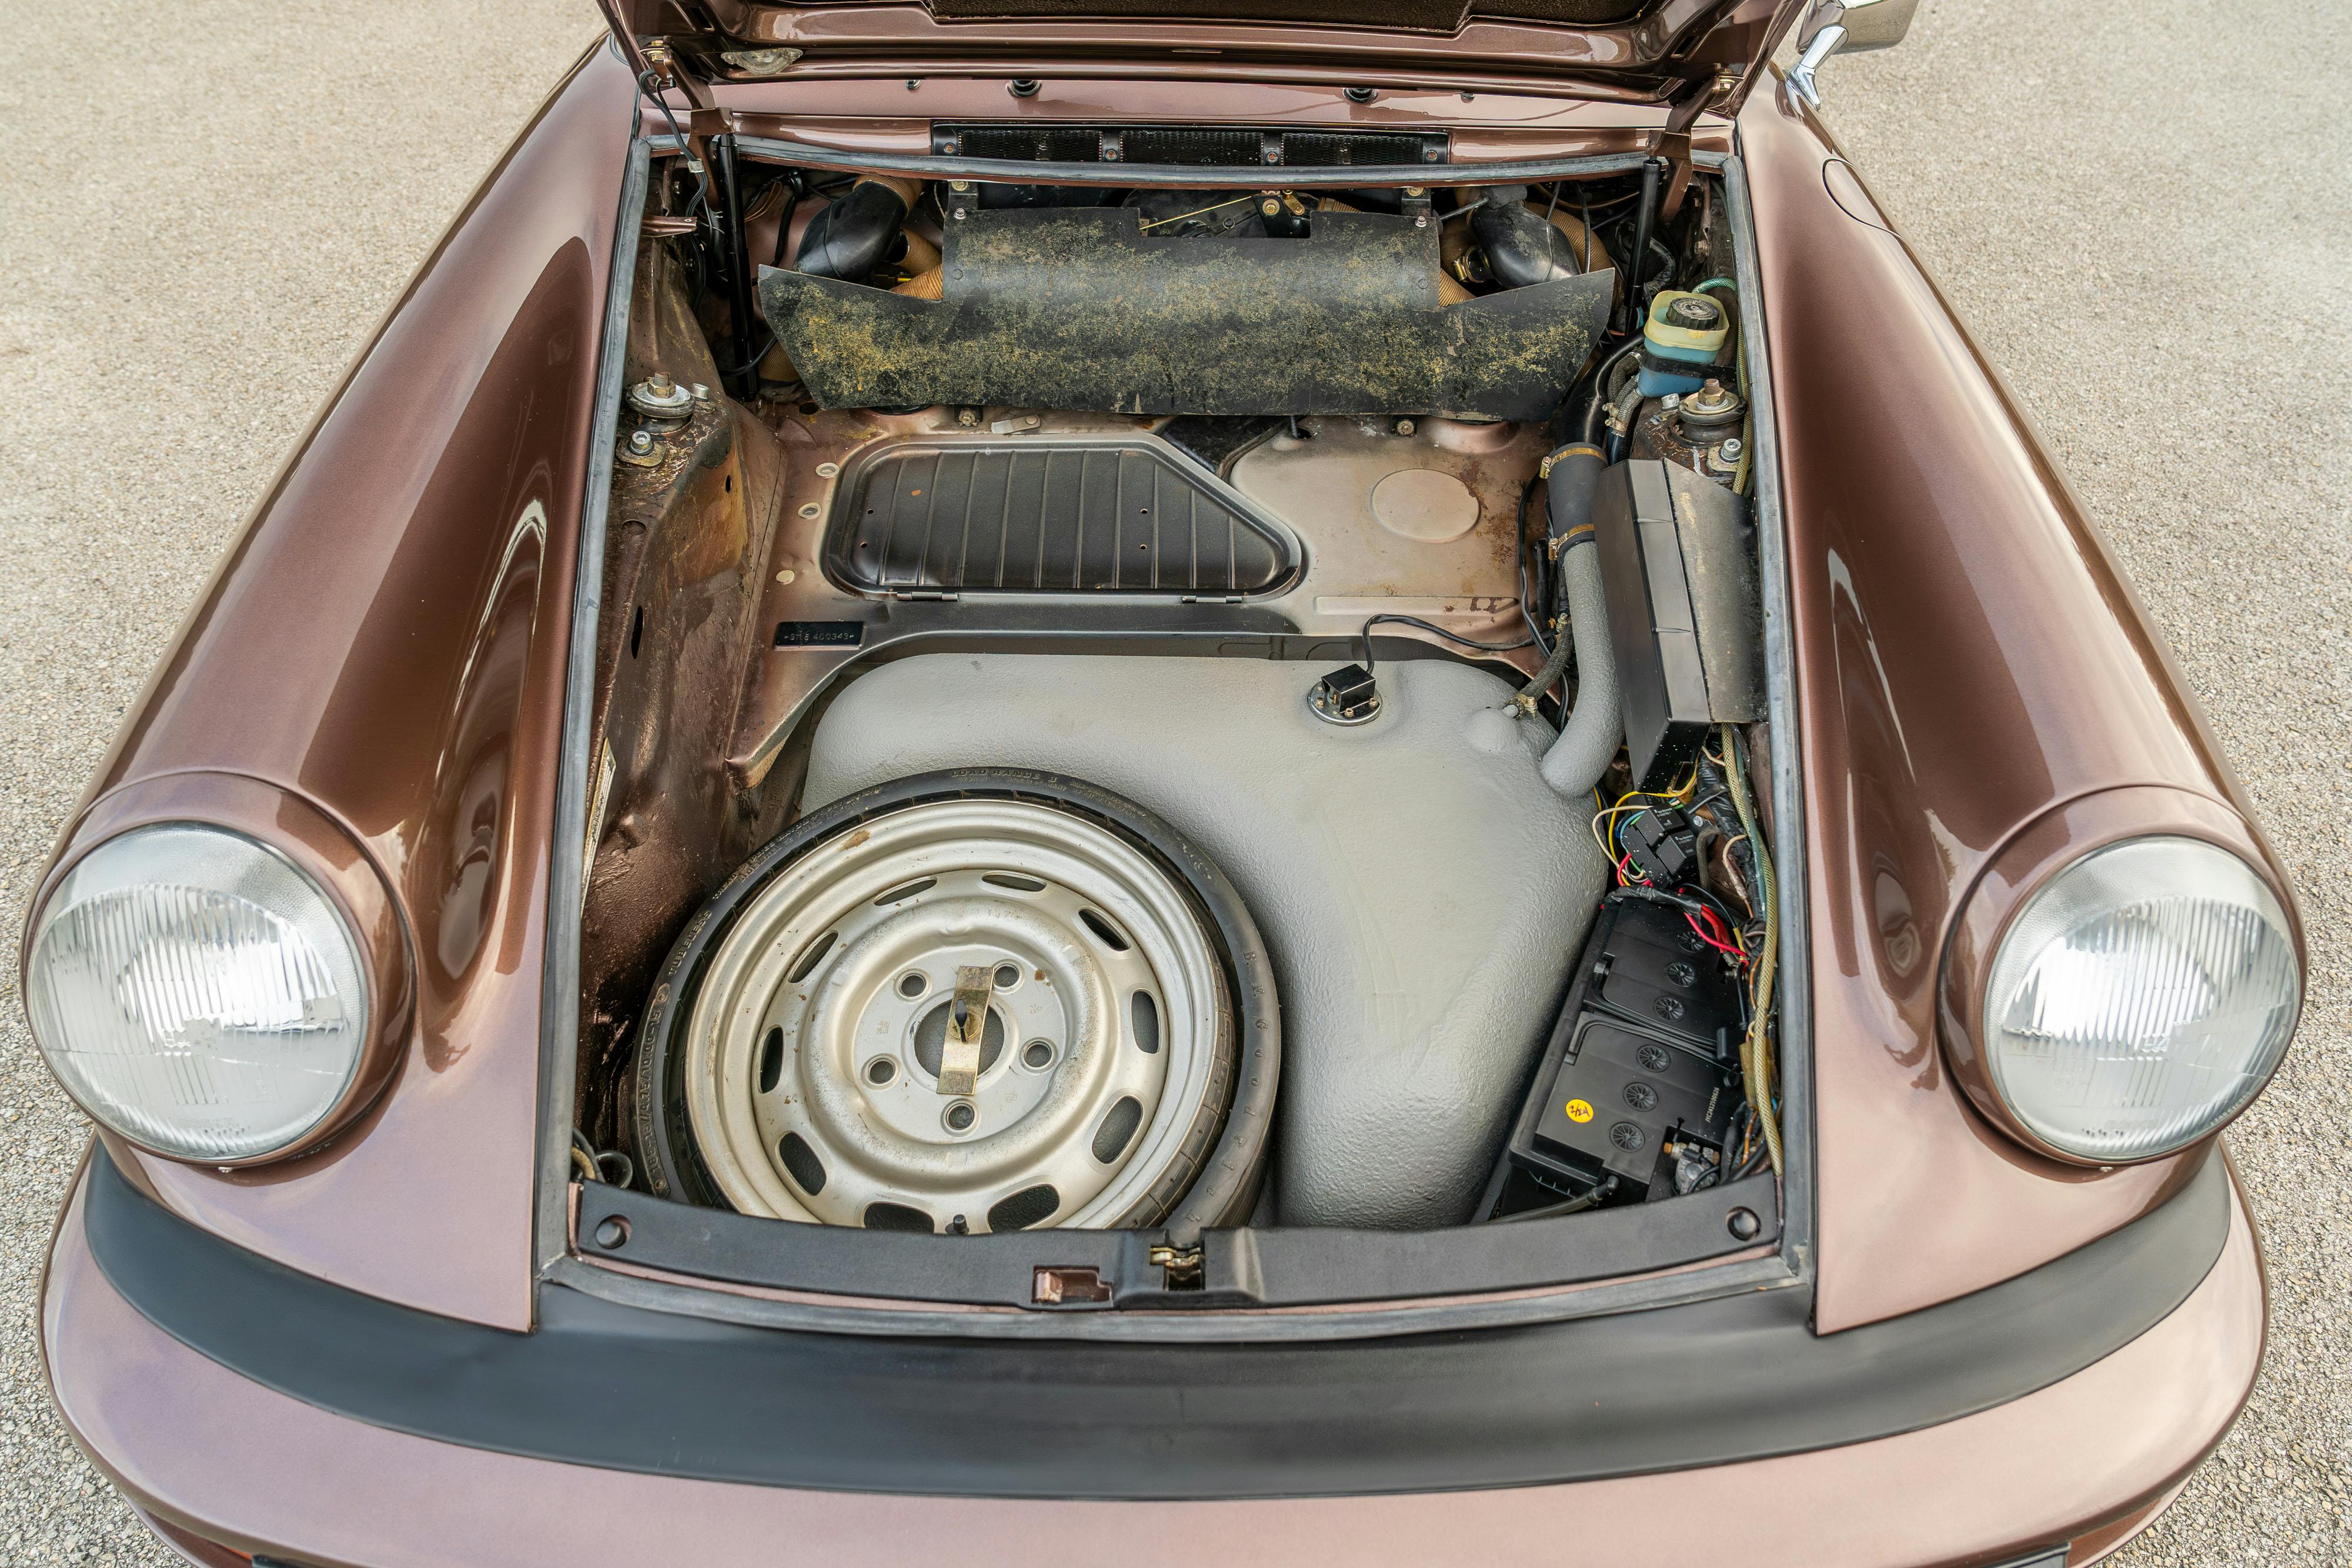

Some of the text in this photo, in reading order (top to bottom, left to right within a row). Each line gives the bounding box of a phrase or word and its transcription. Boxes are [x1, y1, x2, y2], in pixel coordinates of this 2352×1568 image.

[952, 769, 987, 777] LOAD
[993, 769, 1041, 780] RANGE
[667, 911, 713, 976] TUBELESS
